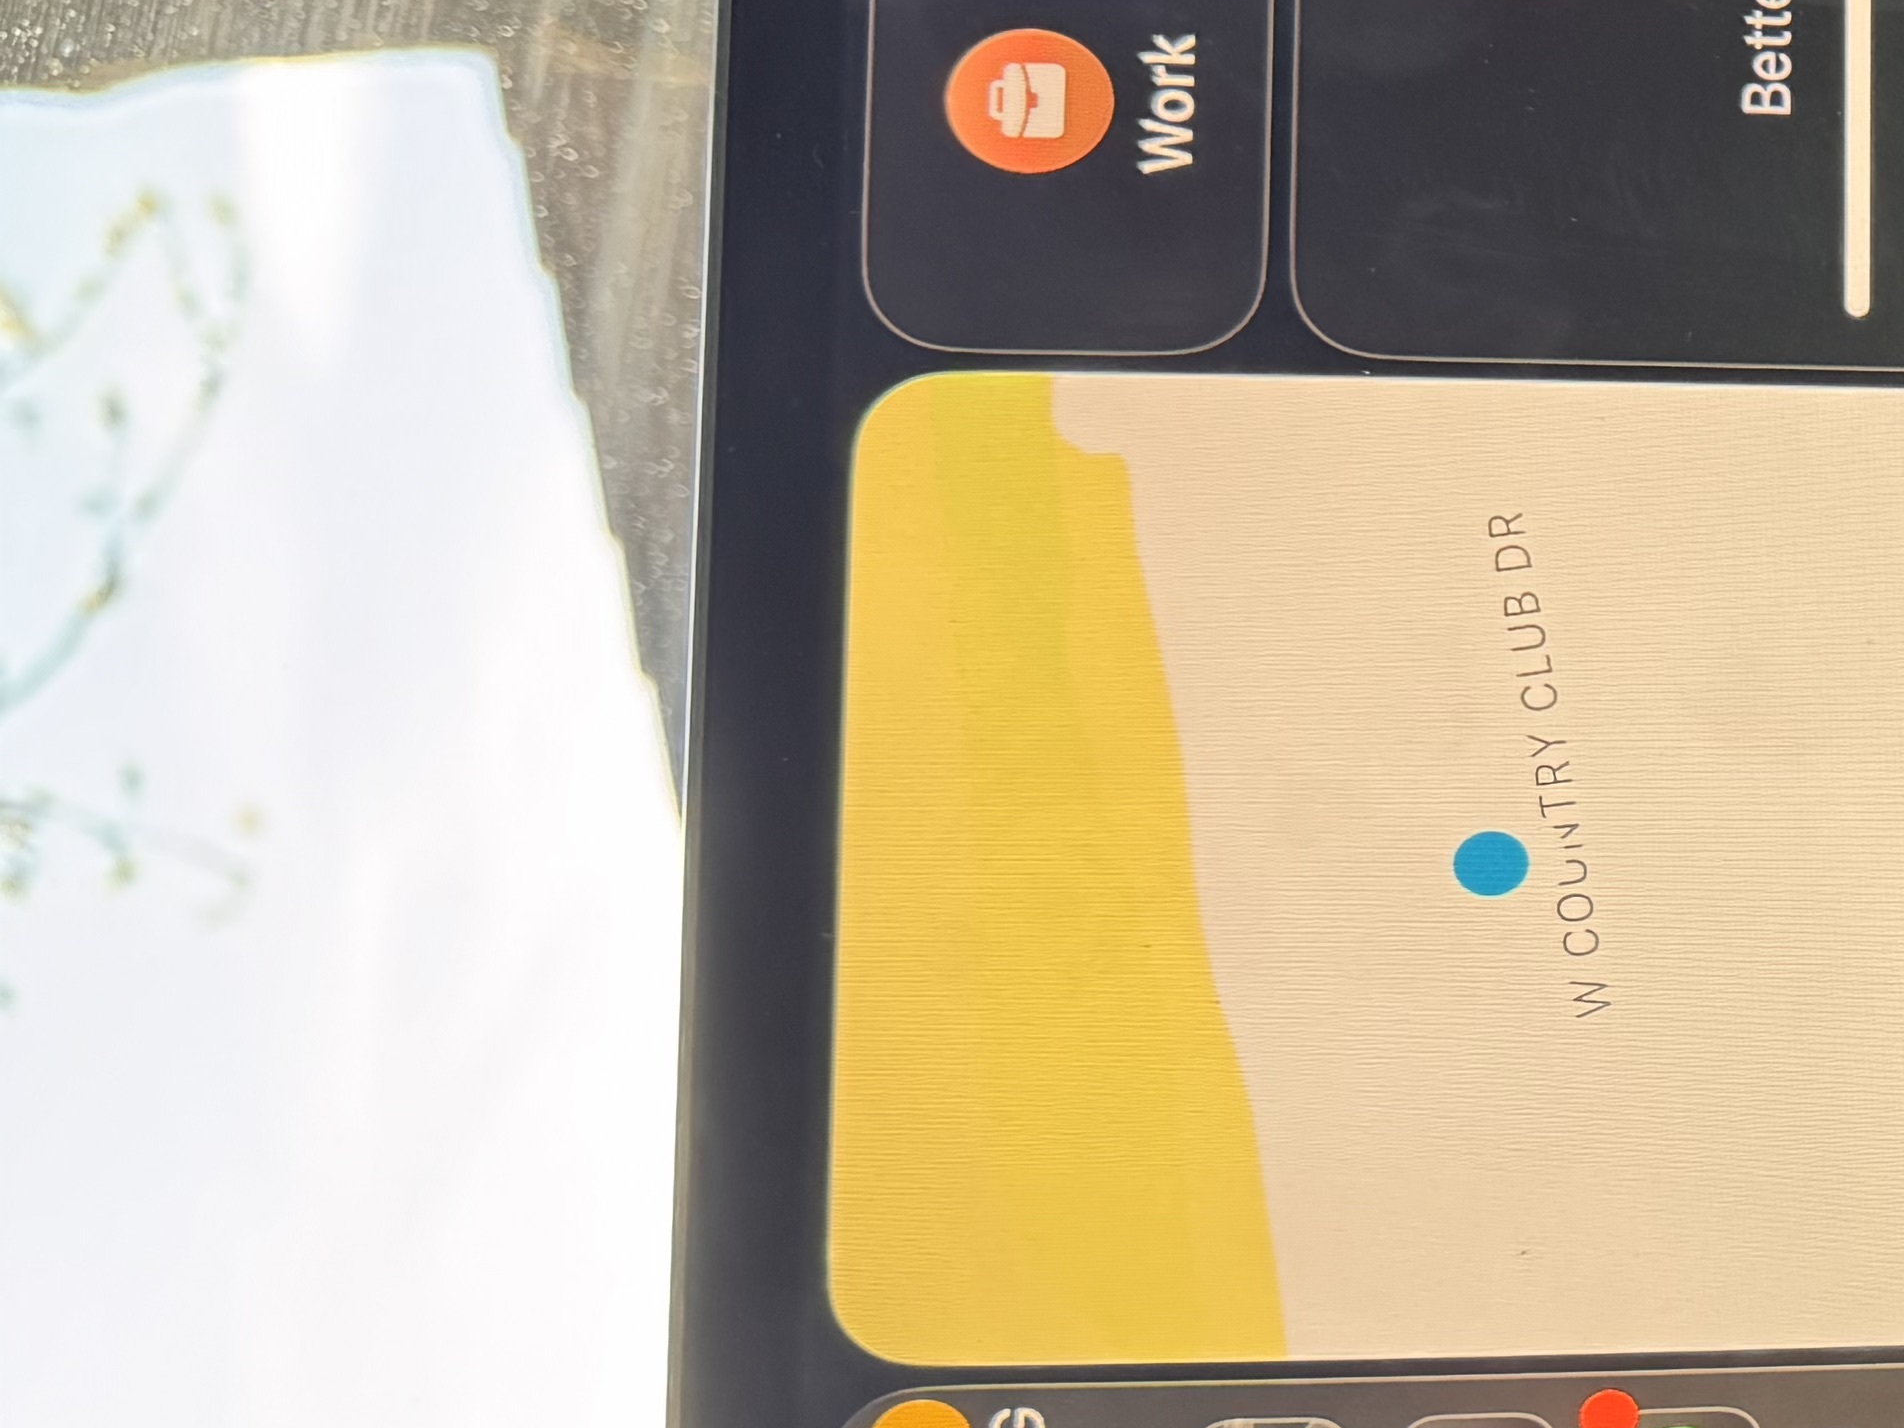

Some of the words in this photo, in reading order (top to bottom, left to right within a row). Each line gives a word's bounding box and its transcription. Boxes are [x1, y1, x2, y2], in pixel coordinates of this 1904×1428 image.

[1137, 32, 1200, 173] Work
[1487, 512, 1532, 572] DR
[1503, 590, 1558, 712] CLUB
[1526, 734, 1600, 957] COUNTRY
[1568, 980, 1612, 1019] W
